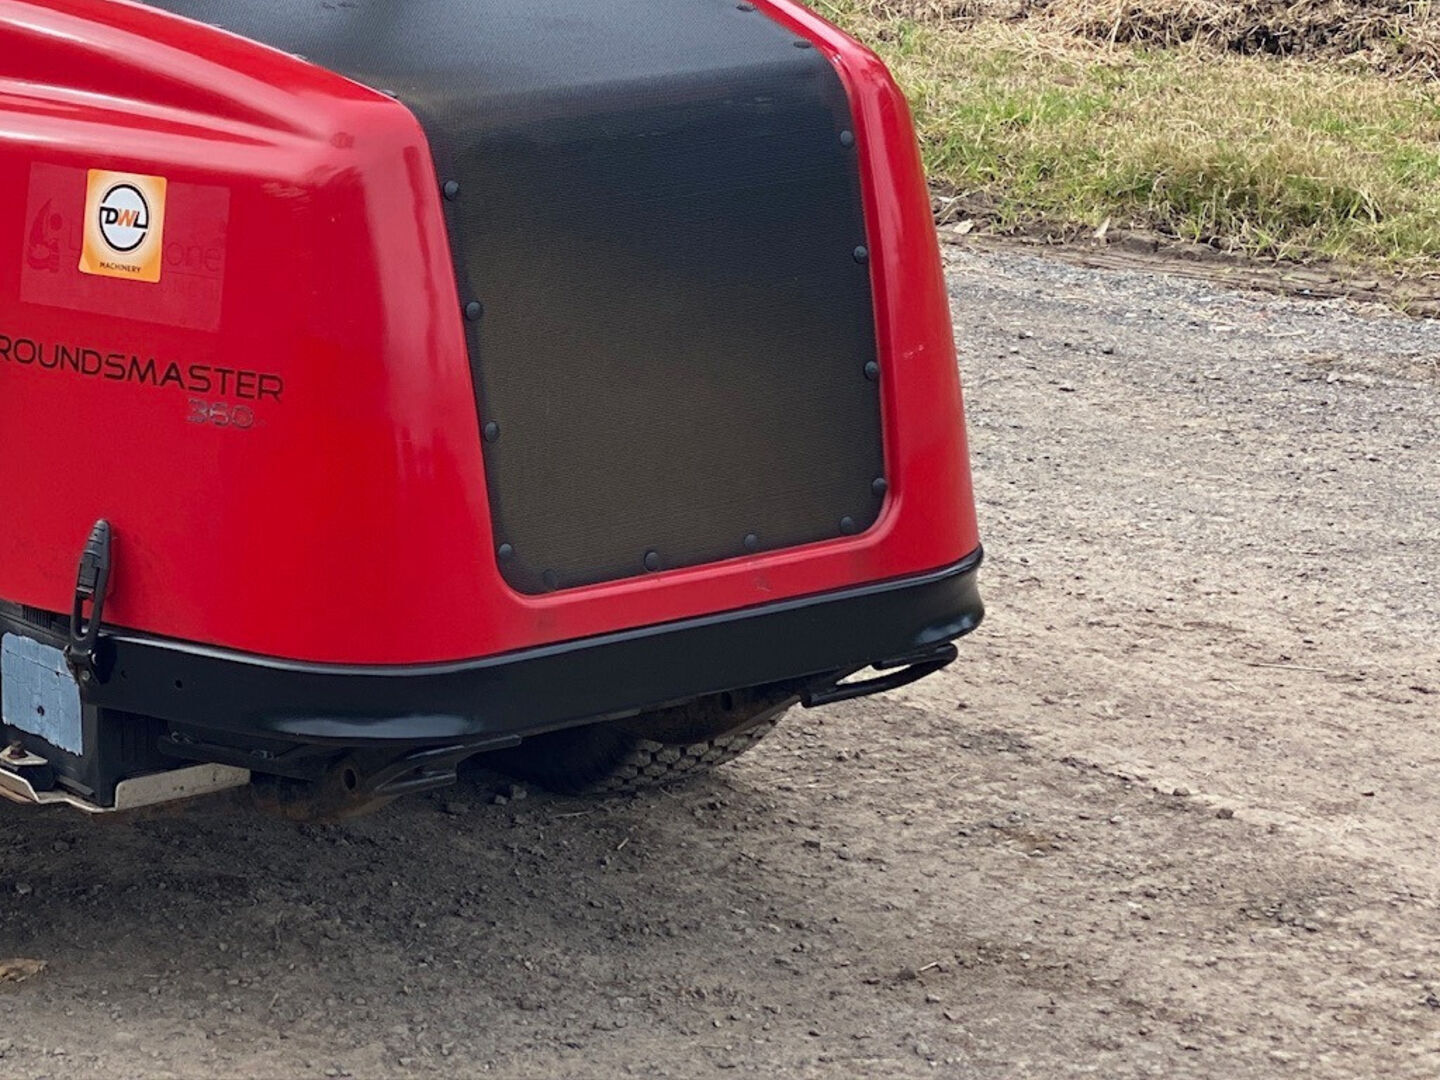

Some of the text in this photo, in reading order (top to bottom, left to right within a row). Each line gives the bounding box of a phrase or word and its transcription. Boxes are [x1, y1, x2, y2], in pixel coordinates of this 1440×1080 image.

[100, 207, 148, 229] DWL
[99, 261, 141, 273] MACHINERY
[187, 399, 254, 429] 360
